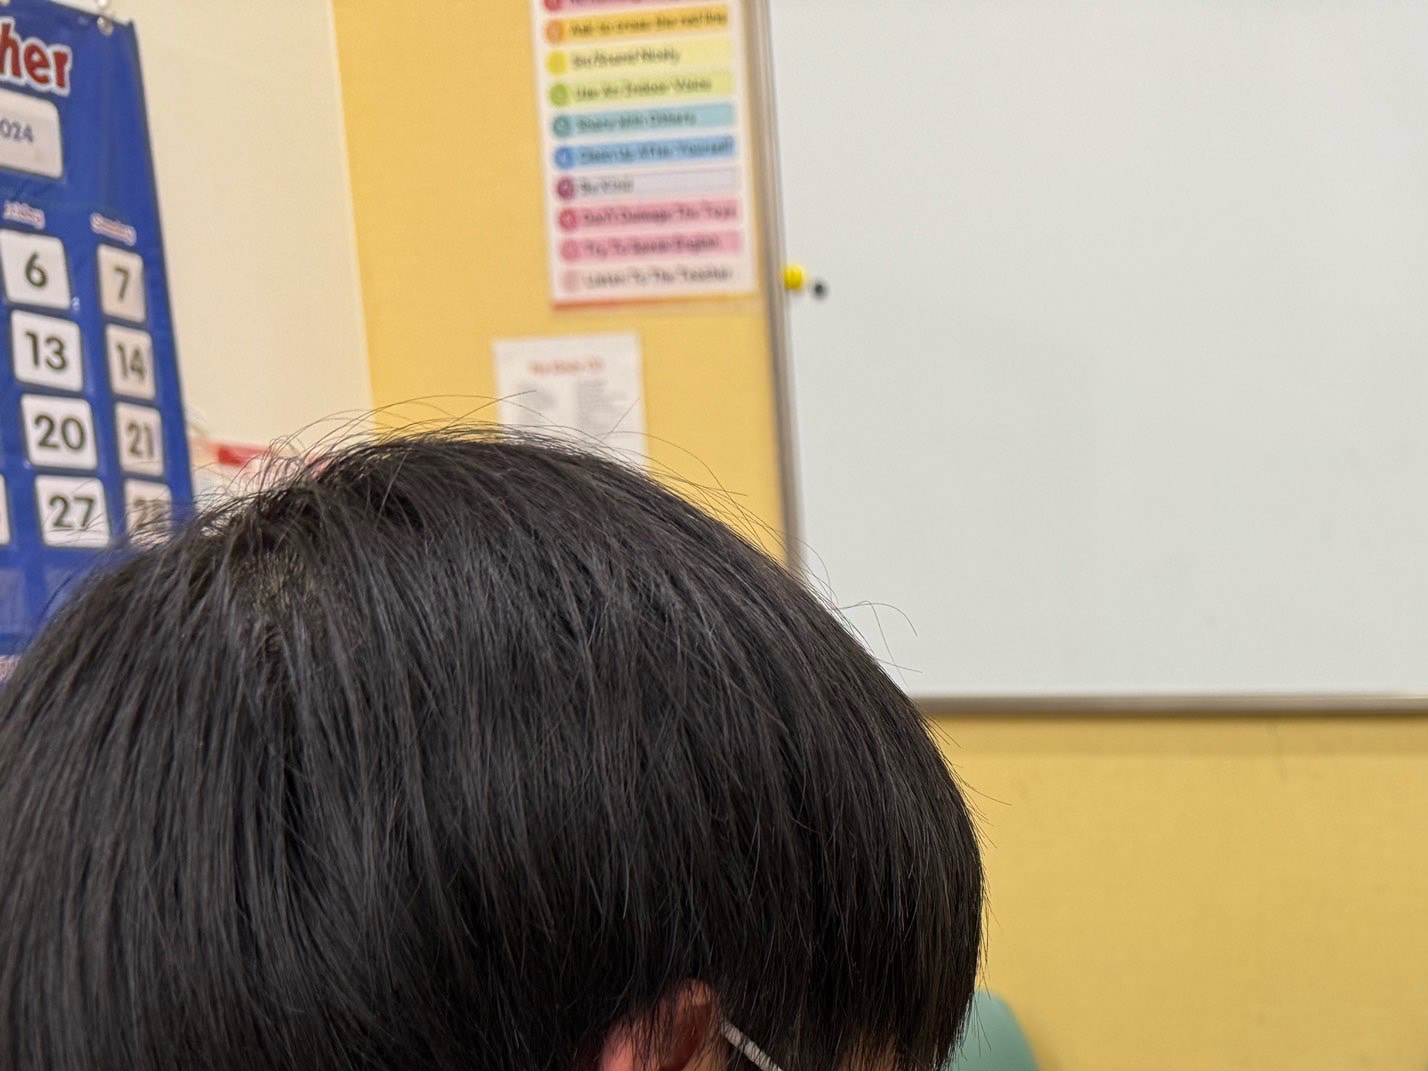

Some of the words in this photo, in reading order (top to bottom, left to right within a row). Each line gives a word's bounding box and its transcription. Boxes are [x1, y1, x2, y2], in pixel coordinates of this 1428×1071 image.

[24, 251, 48, 289] 6
[113, 264, 130, 302] 7
[24, 330, 68, 372] 13
[116, 342, 147, 381] 14
[34, 414, 86, 451] 20
[127, 420, 155, 458] 21
[49, 495, 95, 529] 27
